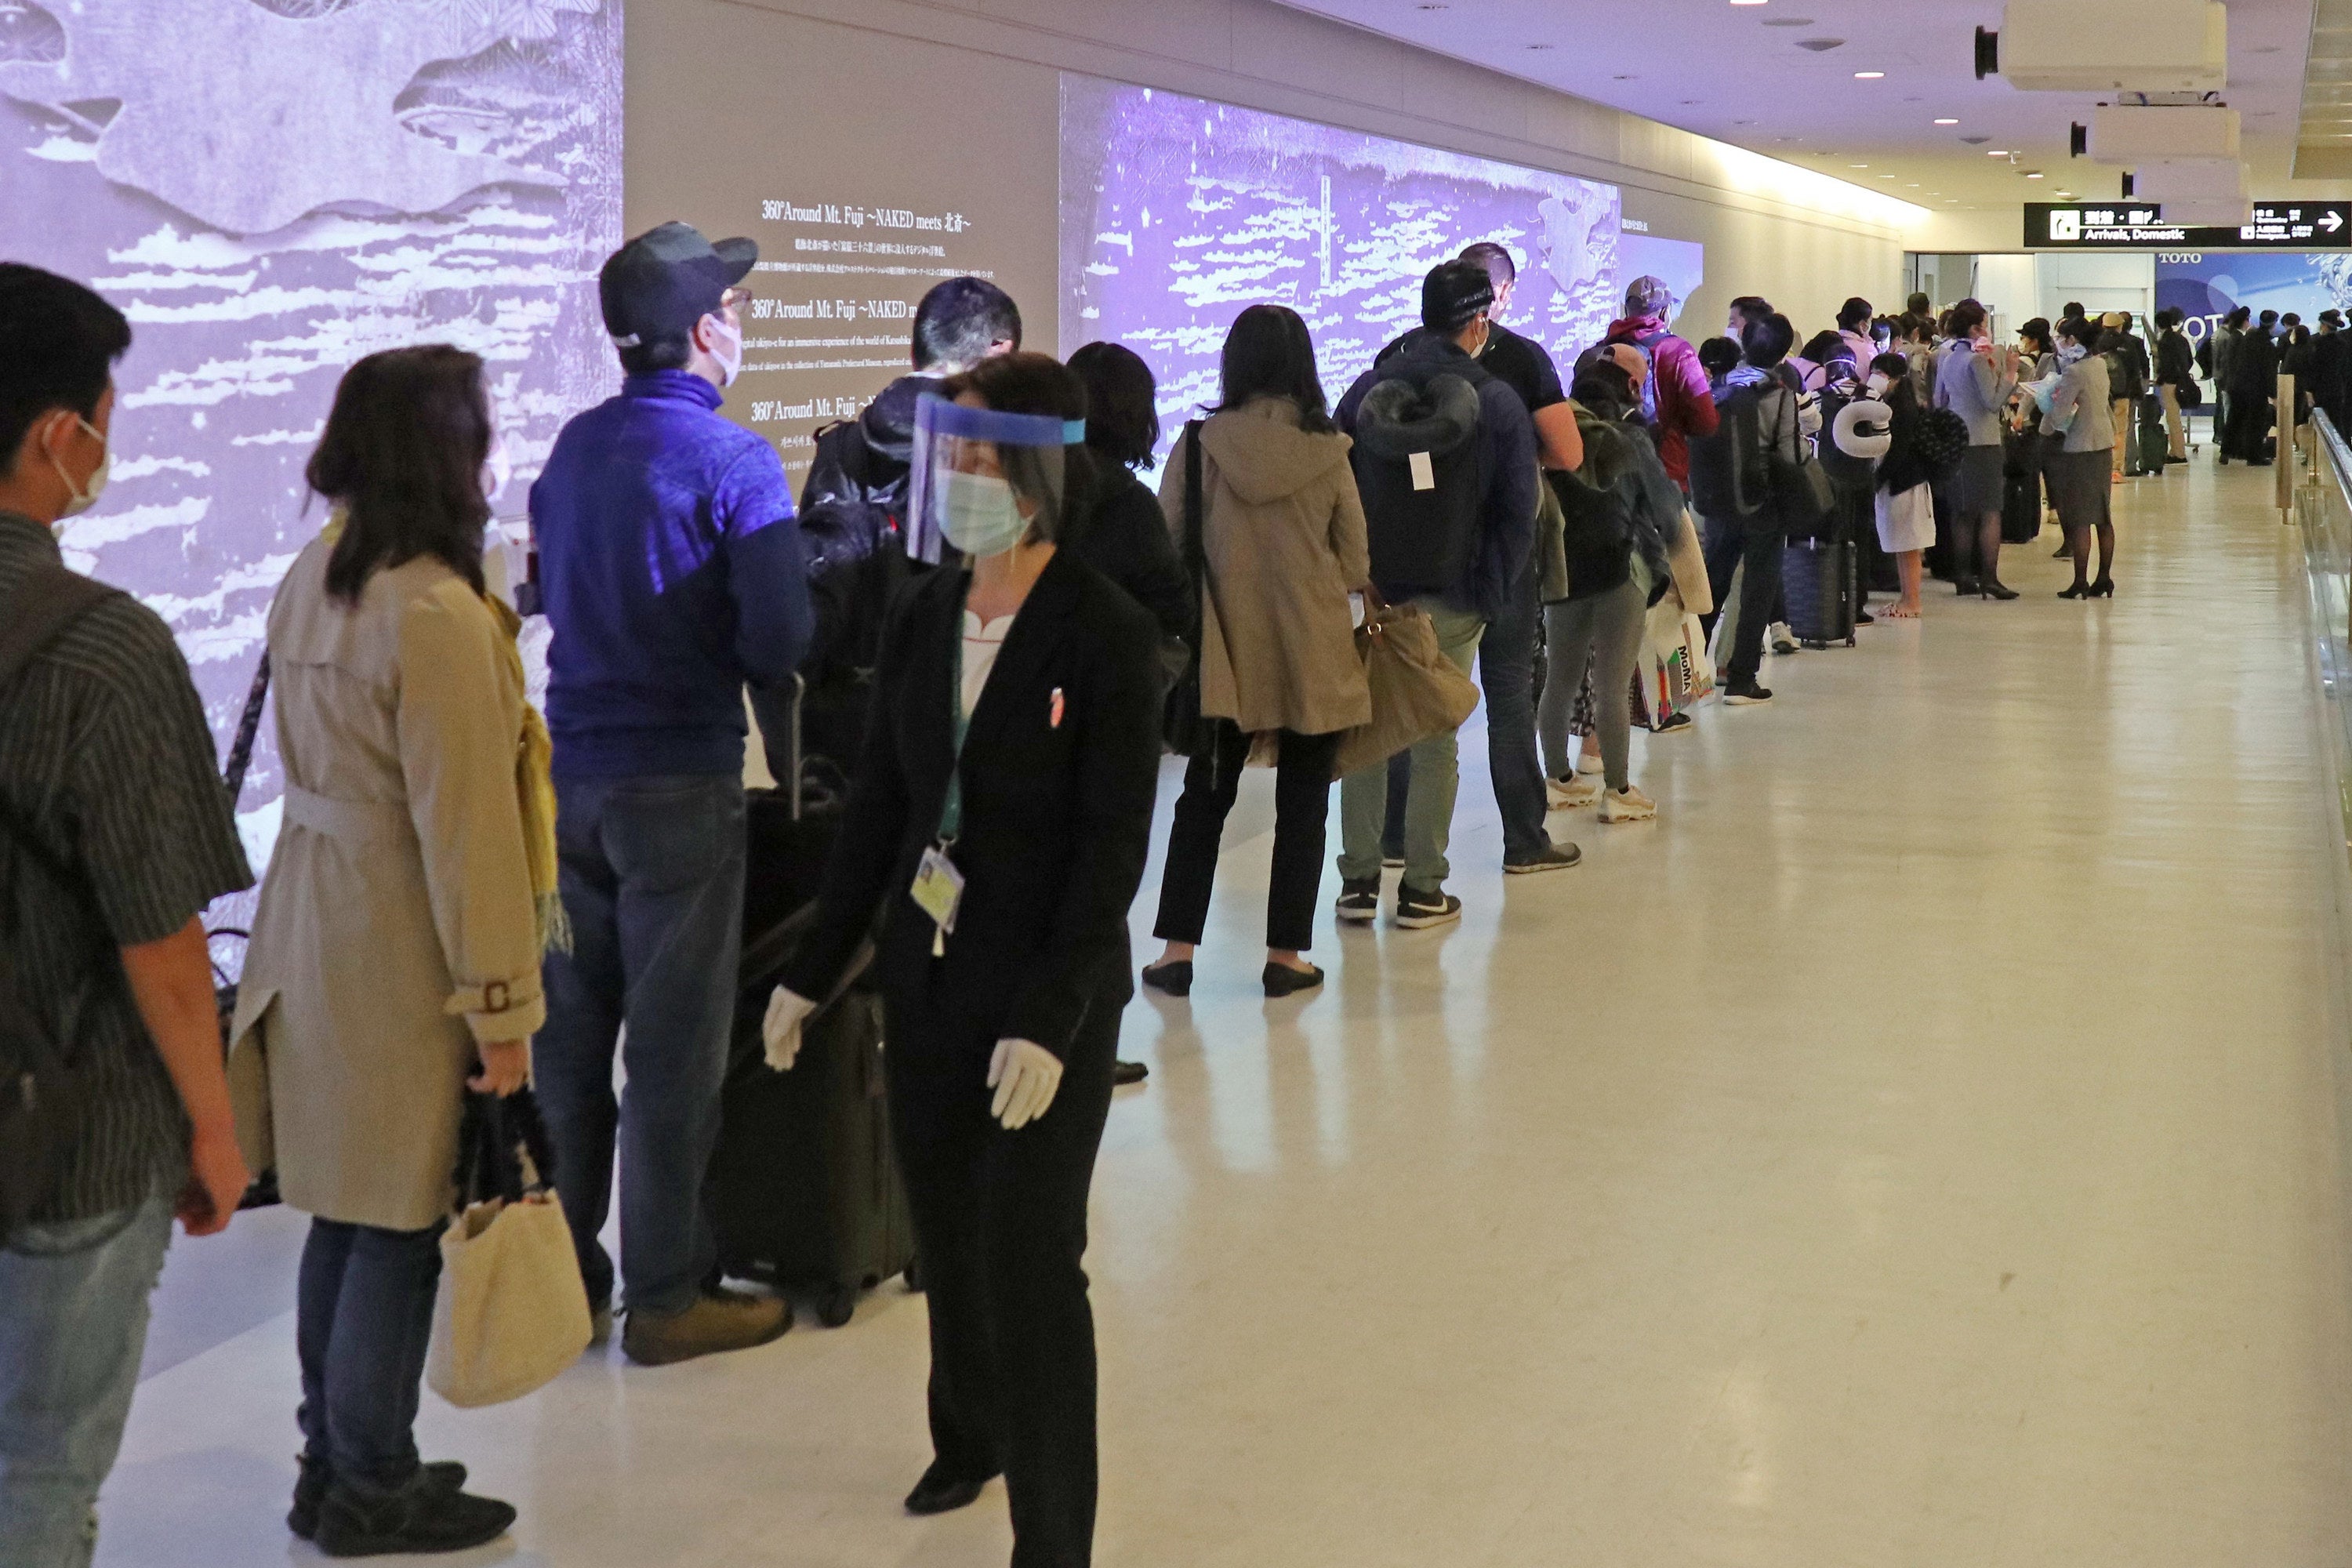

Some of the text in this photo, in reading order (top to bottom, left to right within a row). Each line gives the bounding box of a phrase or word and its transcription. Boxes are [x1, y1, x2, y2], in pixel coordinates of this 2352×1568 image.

[825, 204, 842, 223] Mt.
[844, 205, 864, 228] Fuji
[916, 215, 942, 230] meets
[2085, 228, 2185, 241] Arrivals, Domestic
[2158, 252, 2202, 264] TOTO
[816, 299, 833, 318] Mt.
[836, 299, 856, 321] Fuji
[816, 398, 833, 417] Mt.
[836, 396, 855, 418] Fuji
[1678, 645, 1691, 691] MoMA
